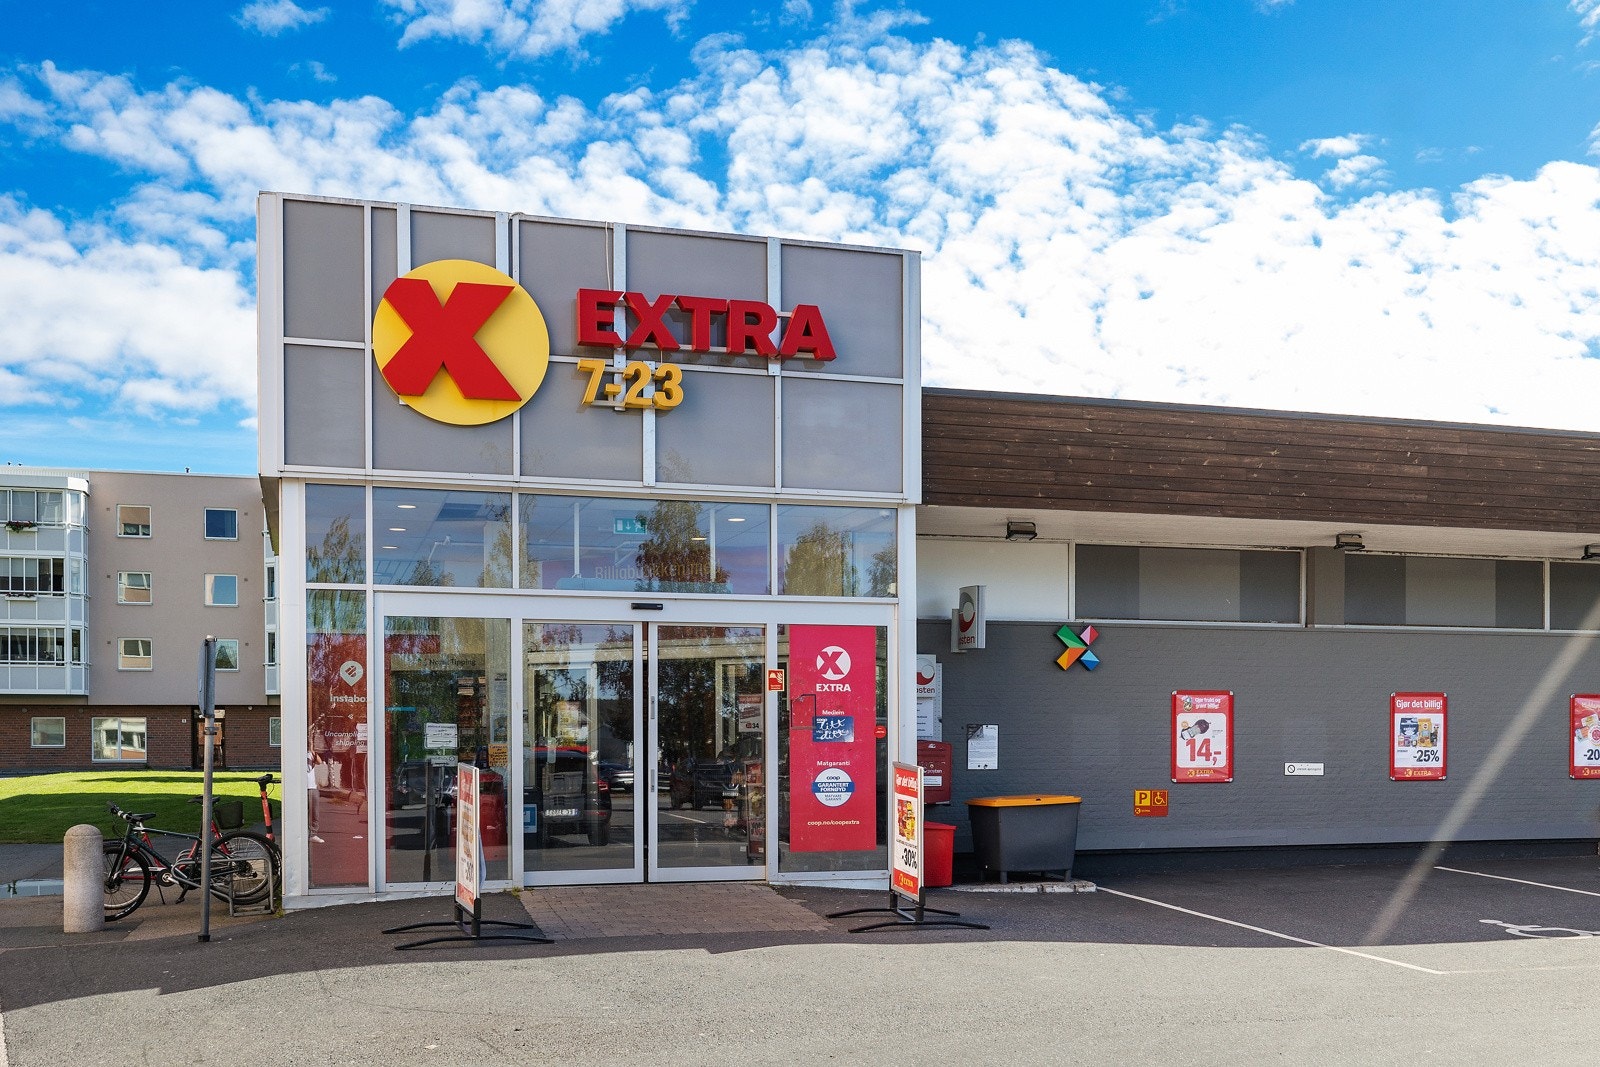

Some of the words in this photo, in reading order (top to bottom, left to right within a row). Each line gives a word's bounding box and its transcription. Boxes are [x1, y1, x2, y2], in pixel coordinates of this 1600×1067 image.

[576, 288, 837, 361] EXTRA
[577, 359, 684, 411] 7-23
[816, 683, 851, 692] EXTRA
[330, 694, 367, 703] instabo
[1396, 699, 1411, 709] Gjør
[1411, 699, 1423, 708] det
[1424, 699, 1443, 709] billig!
[1186, 738, 1222, 766] 14,-
[1413, 749, 1440, 762] -25%
[1138, 792, 1148, 805] P
[901, 847, 918, 869] -30%
